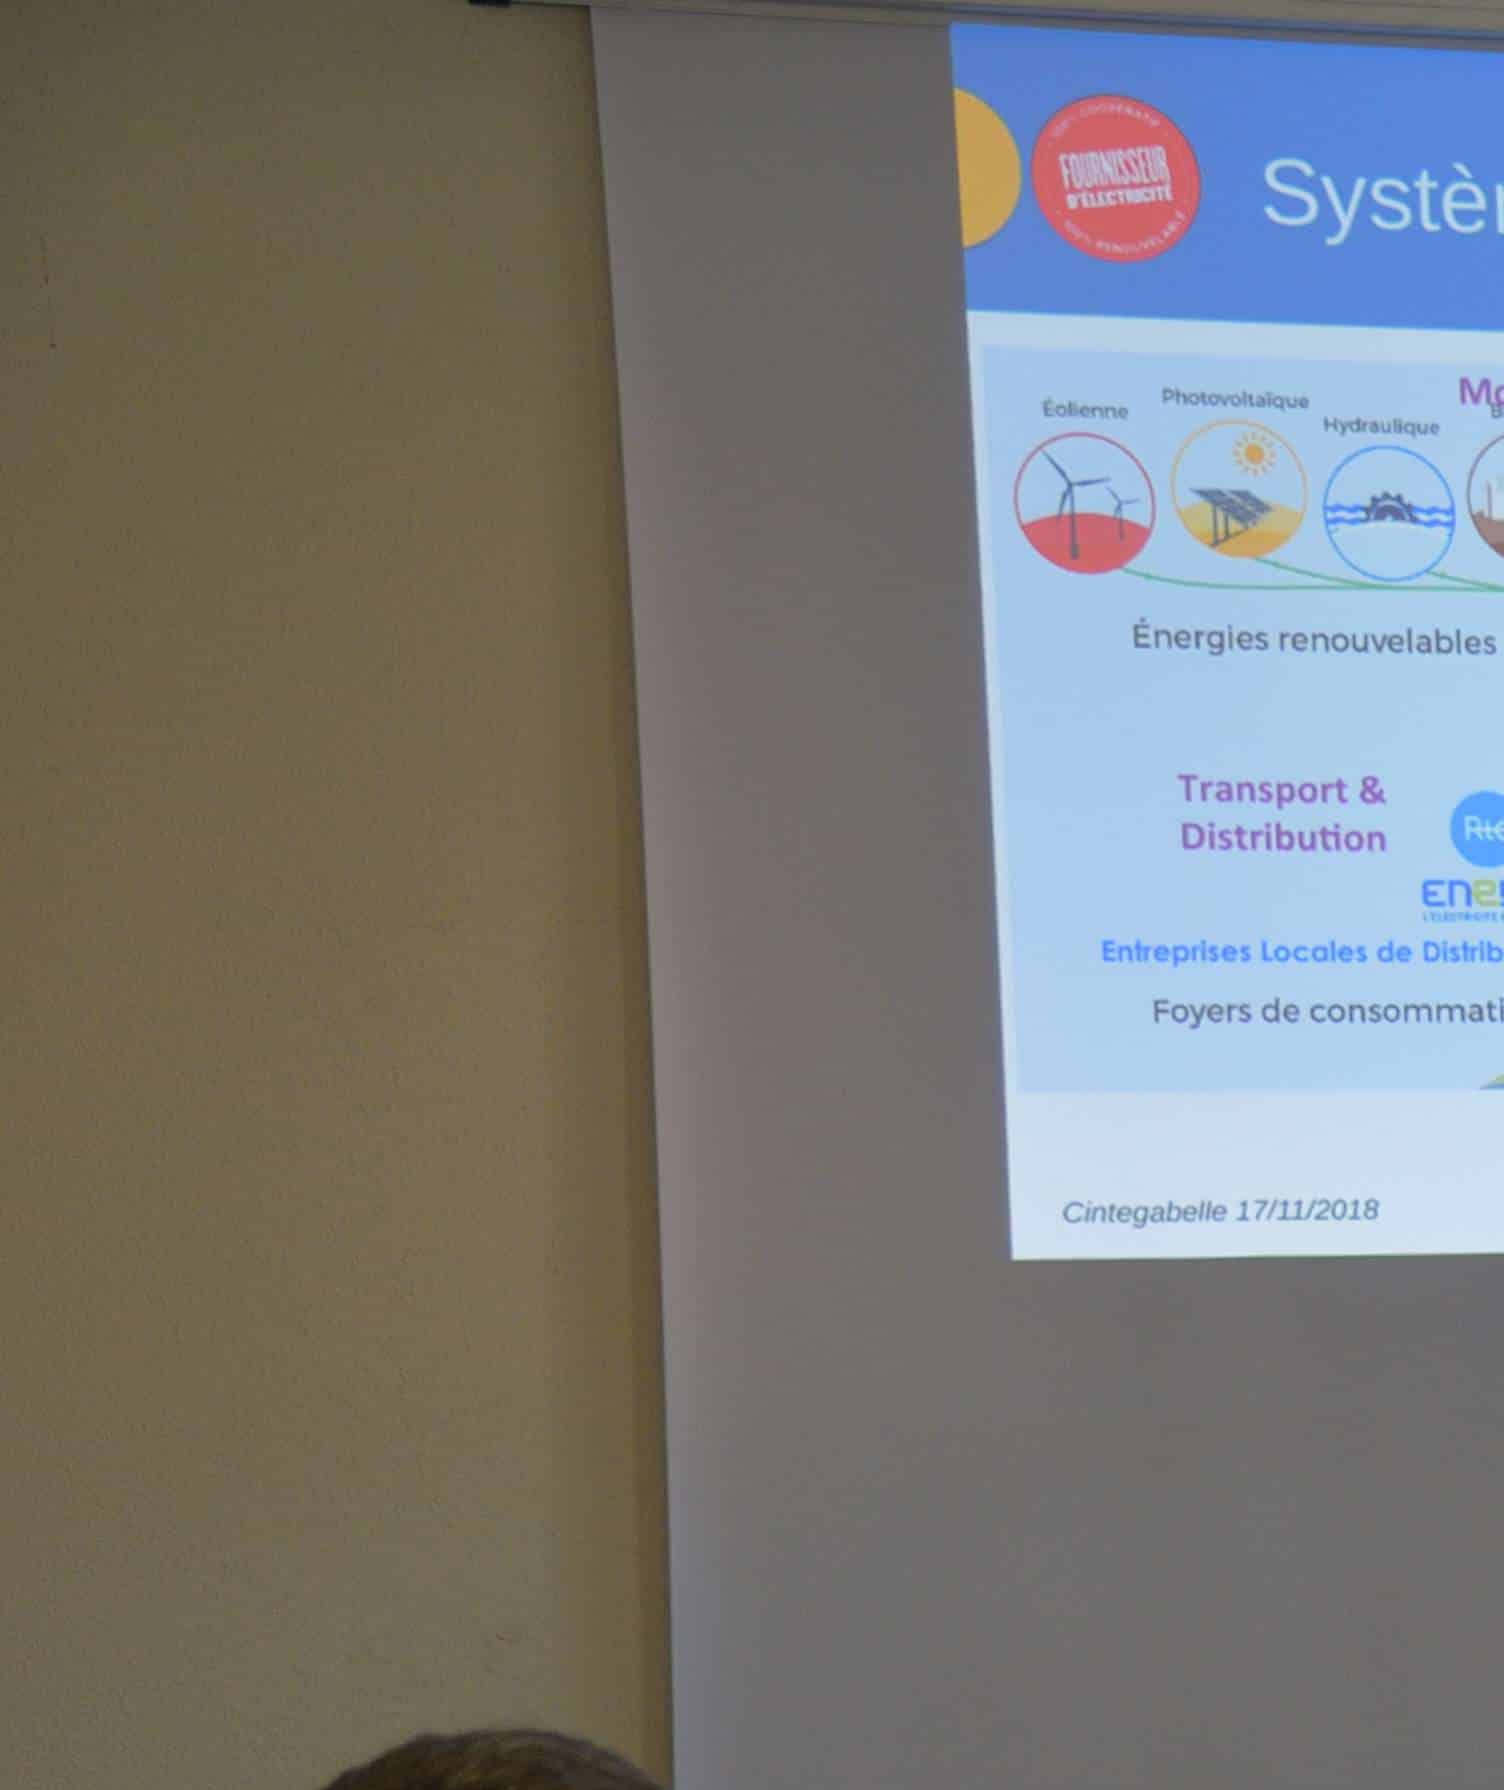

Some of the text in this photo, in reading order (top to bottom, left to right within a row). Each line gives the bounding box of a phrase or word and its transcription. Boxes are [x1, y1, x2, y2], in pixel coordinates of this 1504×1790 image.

[1059, 145, 1171, 189] FOURNISSEUR
[1042, 399, 1128, 421] Éolienne
[1162, 387, 1310, 412] Photovoltaïque
[1324, 415, 1440, 438] Hydraulique
[1132, 618, 1497, 656] Énergies renouvelables
[1178, 774, 1386, 808] Transport &
[1181, 821, 1386, 853] Distribution
[1101, 940, 1251, 966] Entreprises
[1261, 940, 1368, 964] Locales
[1376, 940, 1412, 963] de
[1152, 998, 1251, 1028] Foyers
[1261, 998, 1300, 1023] de
[1062, 1198, 1380, 1227] Cintegabelle 17/11/2018
